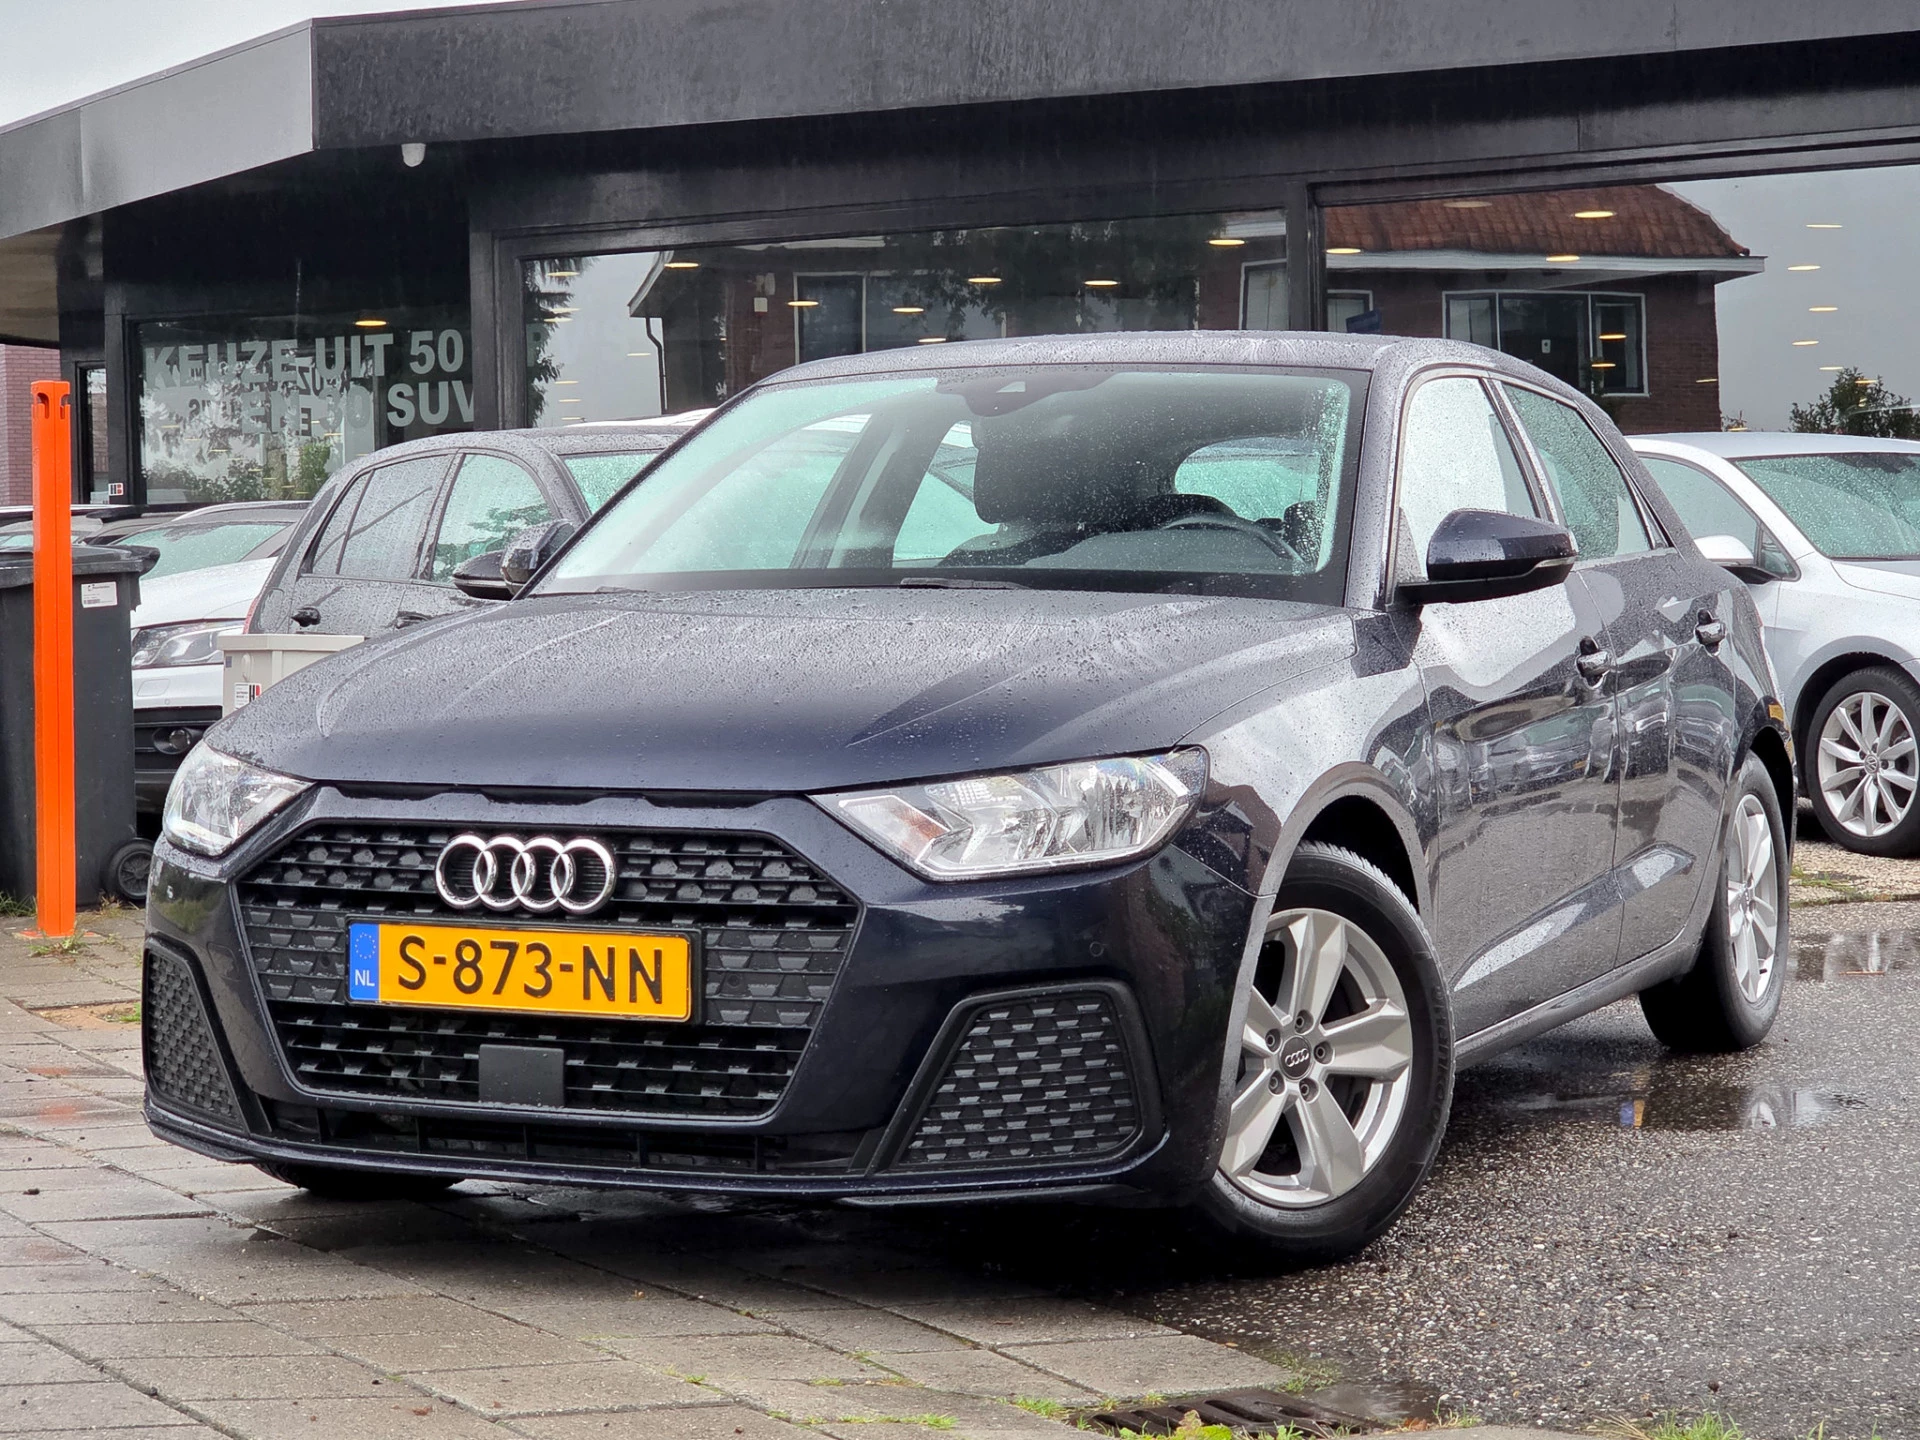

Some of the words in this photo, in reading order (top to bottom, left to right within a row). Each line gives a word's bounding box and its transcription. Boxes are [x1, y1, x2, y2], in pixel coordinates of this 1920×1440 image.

[143, 339, 298, 388] KEUZE
[315, 333, 394, 377] UIT
[409, 328, 464, 374] 50
[387, 380, 475, 427] SUV
[354, 969, 375, 987] NL
[398, 934, 662, 1004] S-873-NN
